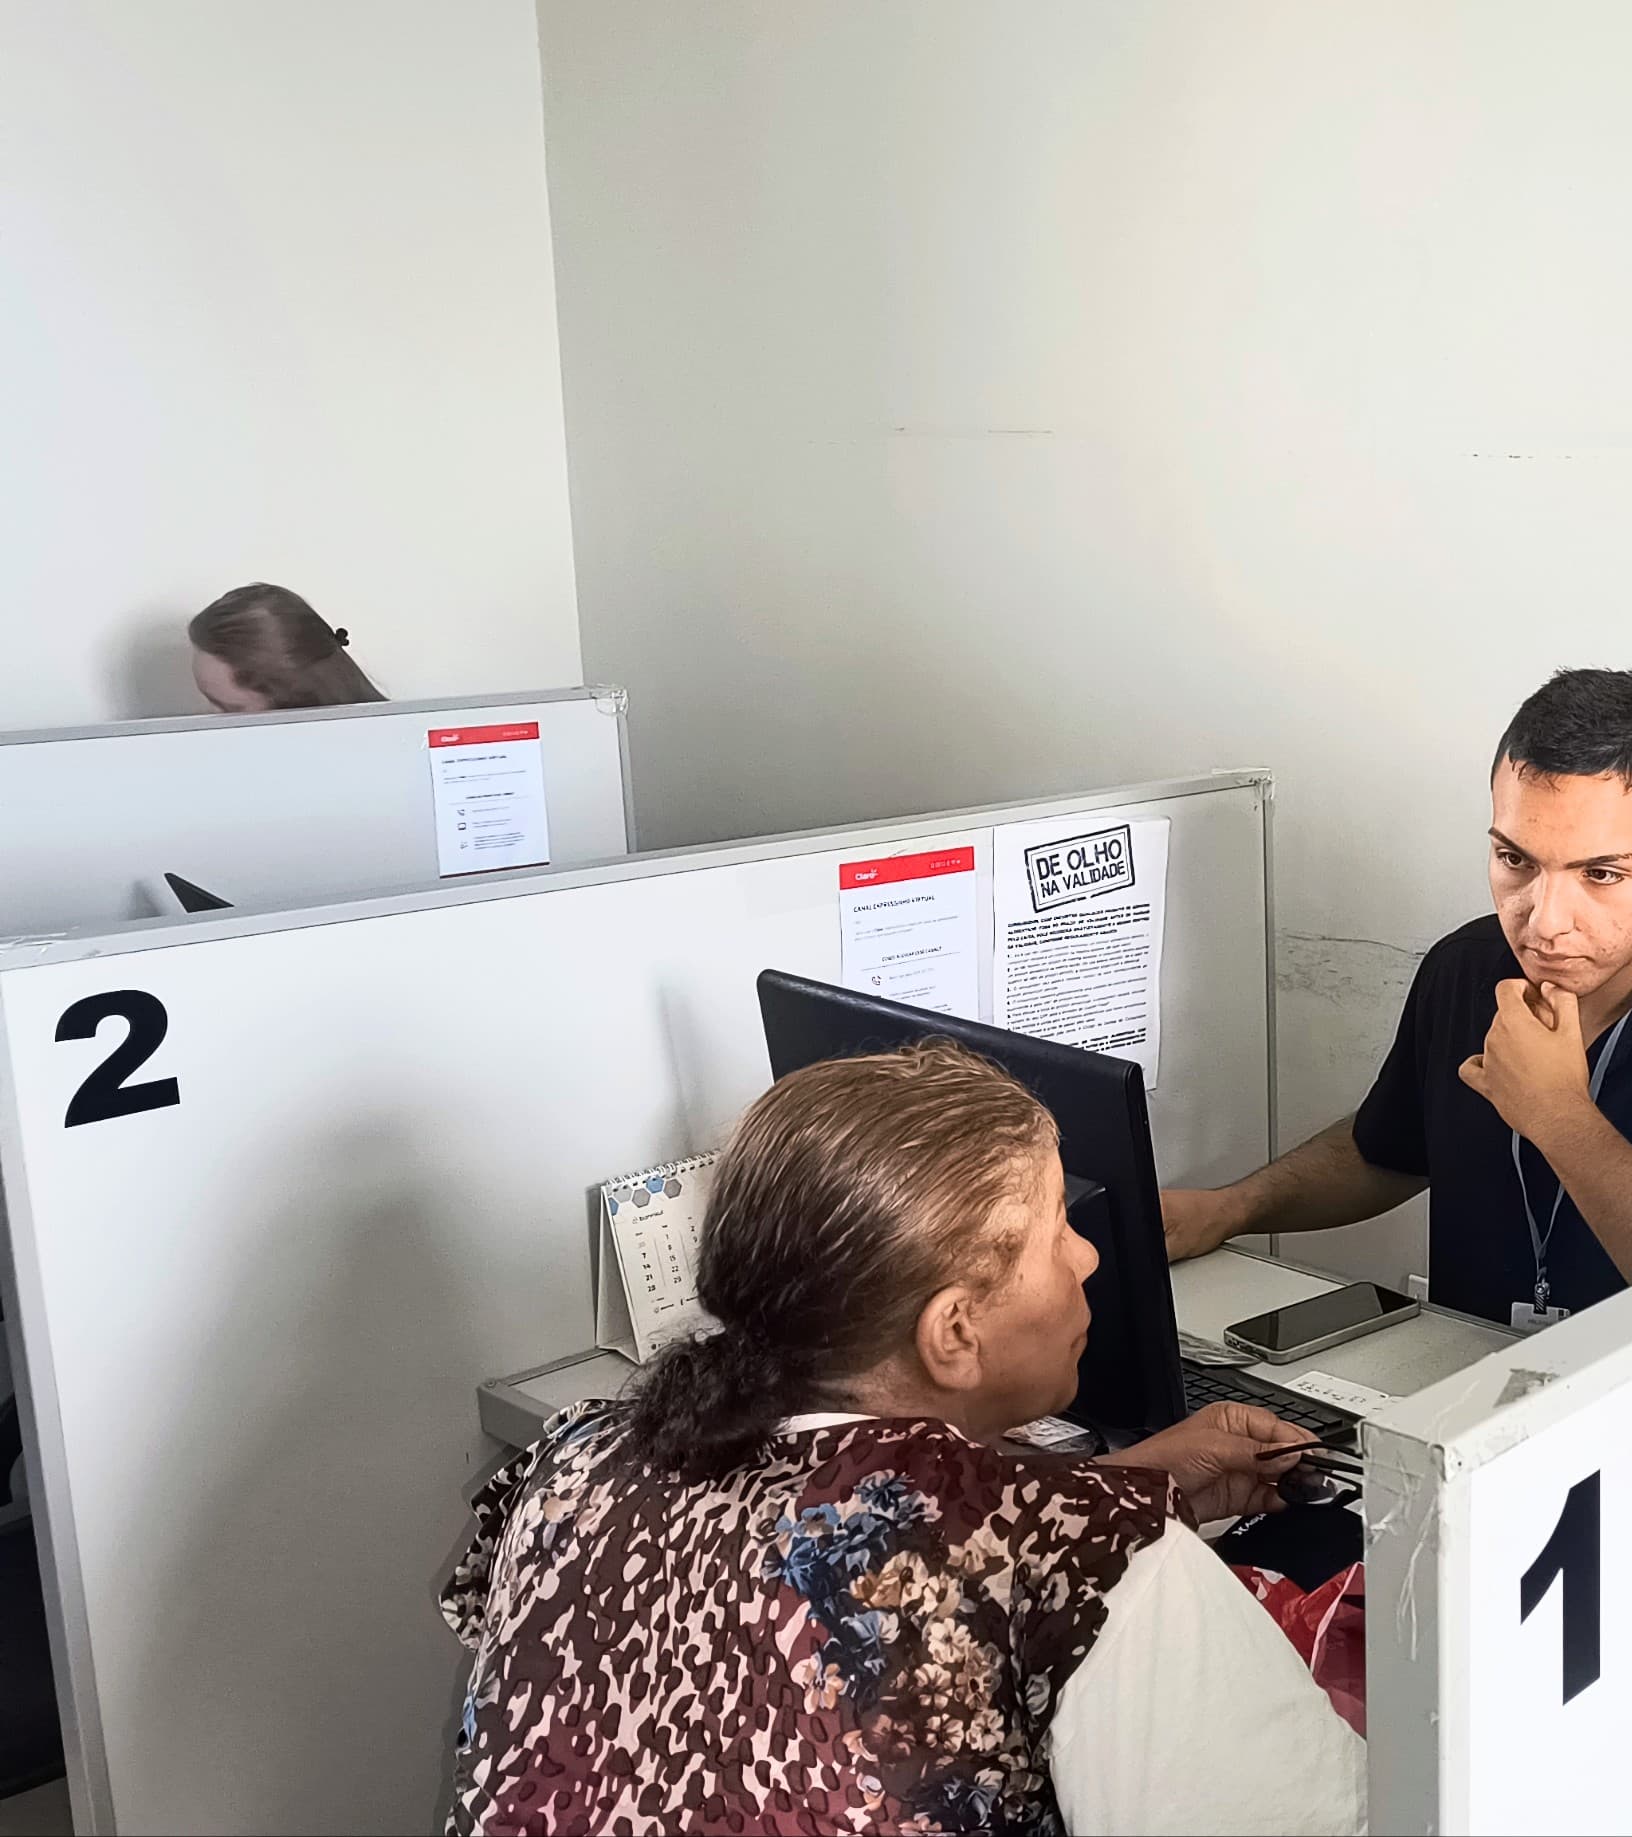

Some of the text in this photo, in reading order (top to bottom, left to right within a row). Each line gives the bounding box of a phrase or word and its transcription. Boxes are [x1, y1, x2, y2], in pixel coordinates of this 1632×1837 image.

[1036, 838, 1122, 880] DE OLHO
[1040, 860, 1126, 898] NA VALIDADE
[54, 989, 181, 1129] 2
[1520, 1468, 1601, 1706] 1
